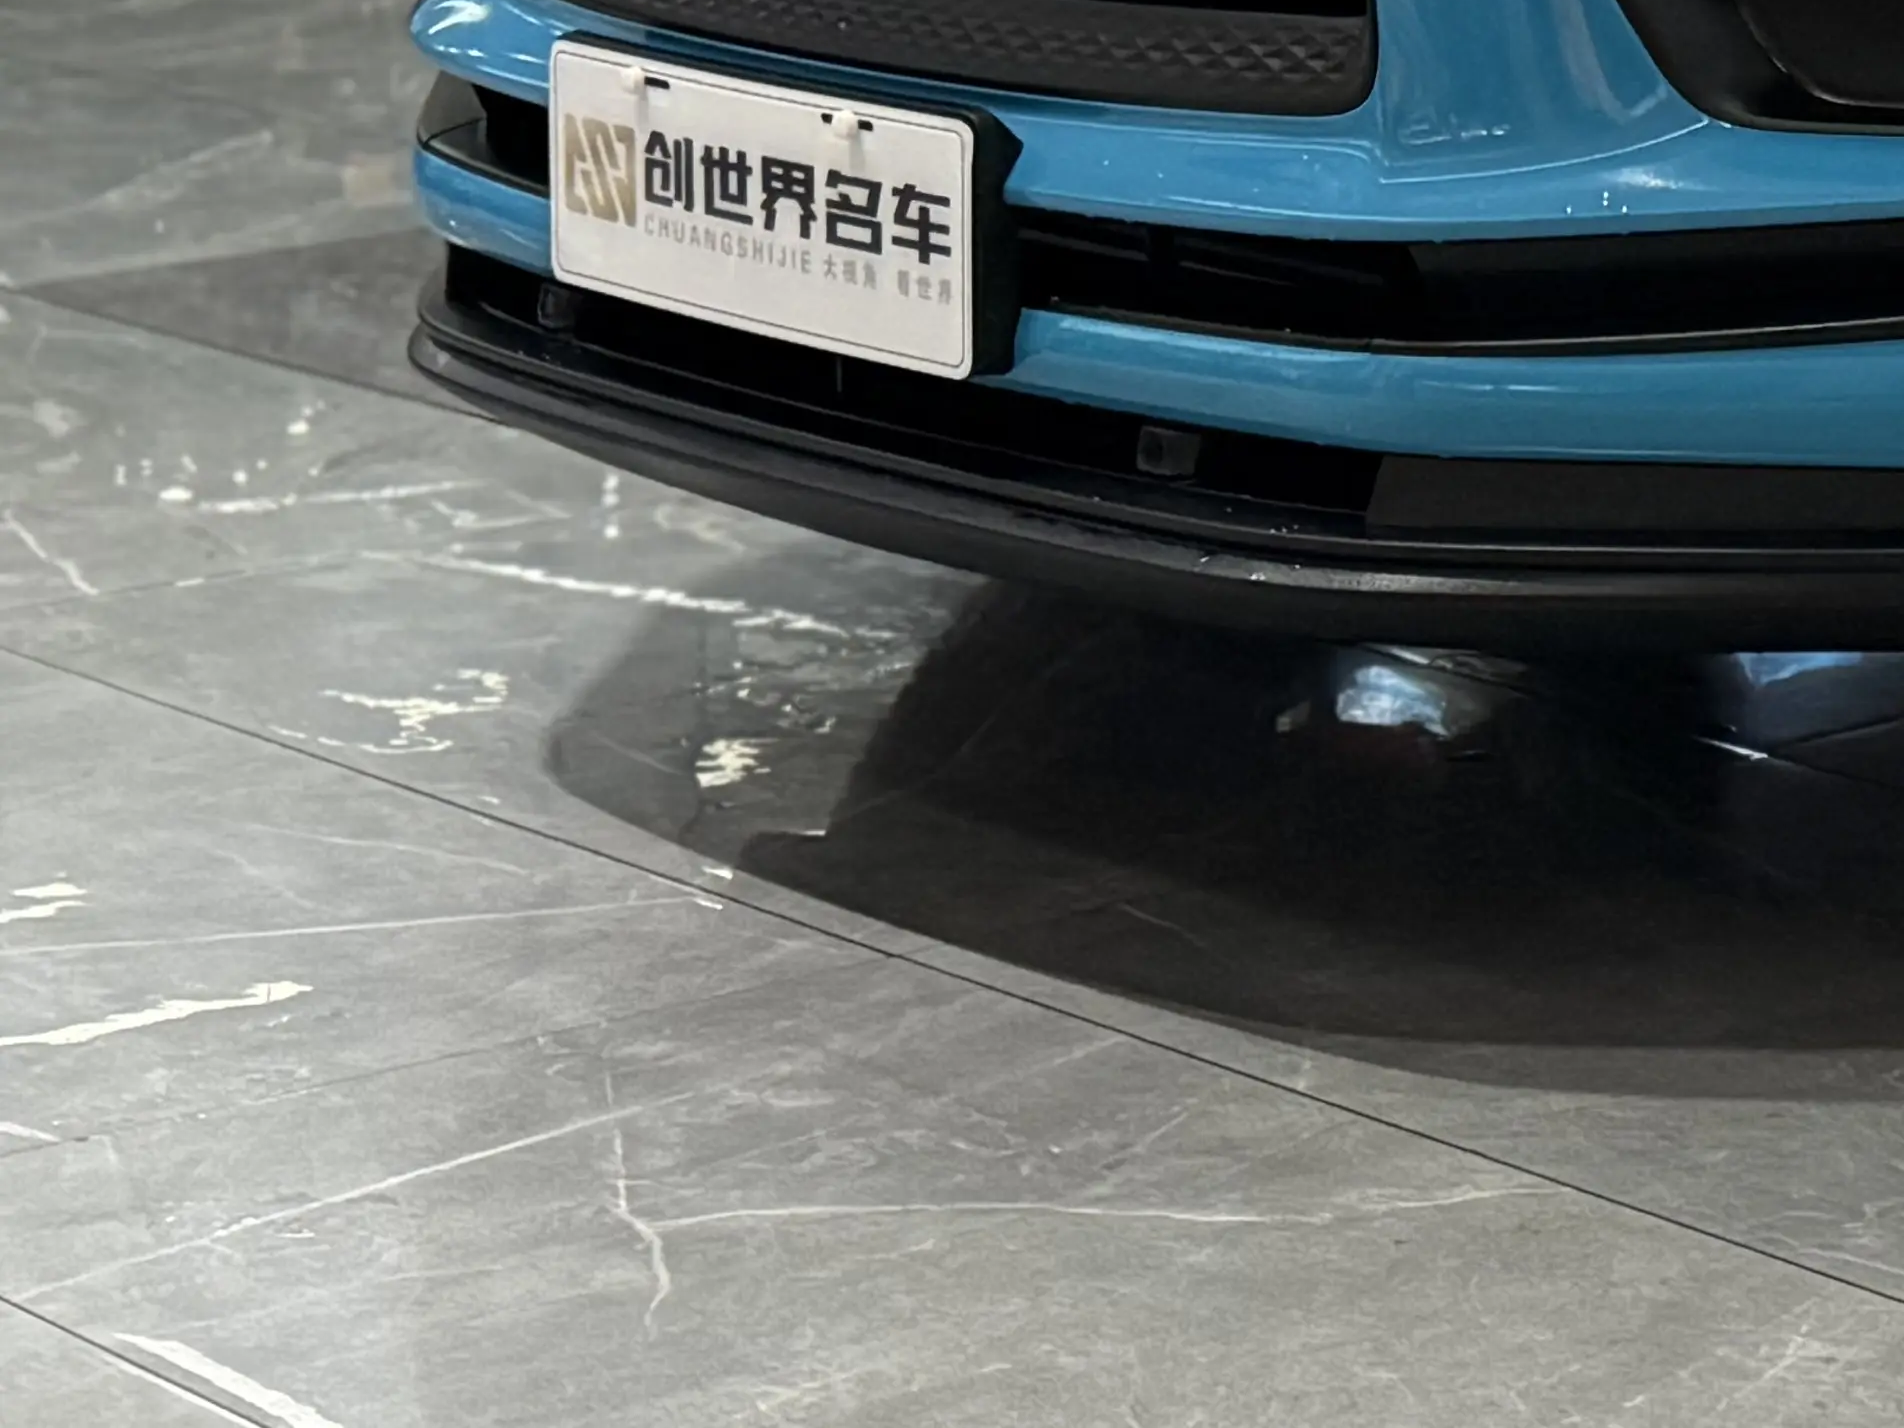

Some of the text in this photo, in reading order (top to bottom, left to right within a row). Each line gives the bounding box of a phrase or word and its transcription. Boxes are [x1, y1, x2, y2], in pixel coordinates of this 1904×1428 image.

[643, 214, 812, 274] CHUANGSHIJIE
[644, 130, 953, 266] 创世界名车
